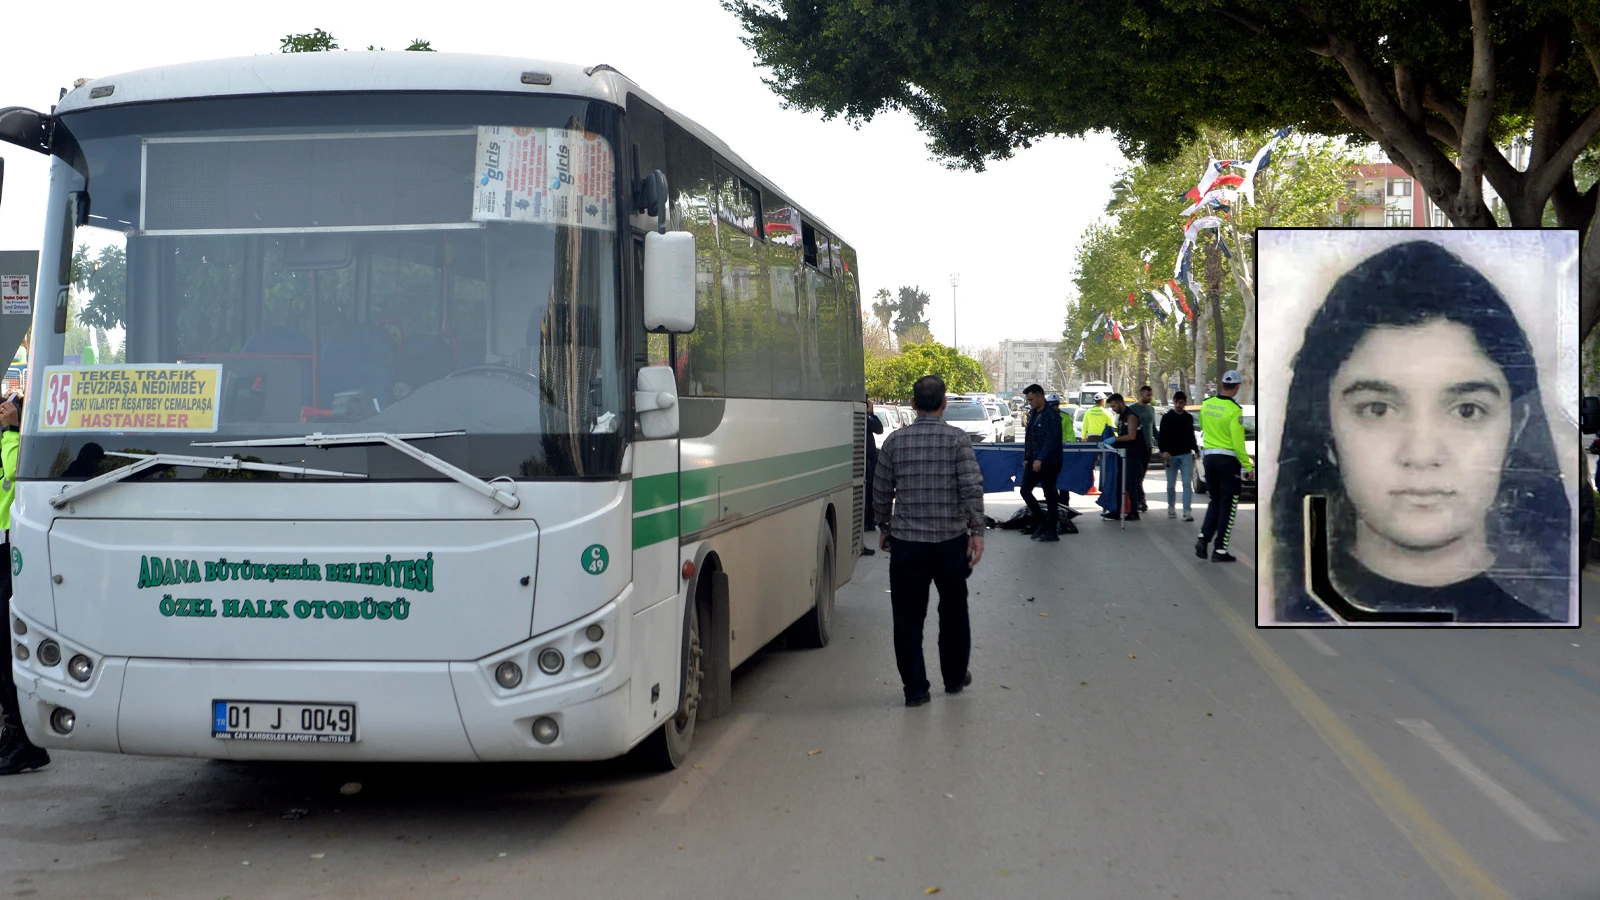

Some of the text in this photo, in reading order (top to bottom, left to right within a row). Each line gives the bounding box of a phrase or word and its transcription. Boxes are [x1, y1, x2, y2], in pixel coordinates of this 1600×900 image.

[79, 371, 130, 381] TEKEL
[46, 374, 71, 425] 35
[81, 413, 189, 428] HASTANELER
[591, 547, 601, 559] C
[138, 552, 434, 592] ADANA BÜYÜKŞEHİR BELEDİYESİ
[589, 559, 604, 572] 49
[159, 594, 410, 620] ÖZEL HALK OTOBÜSÜ
[228, 706, 350, 732] 01 J 0049
